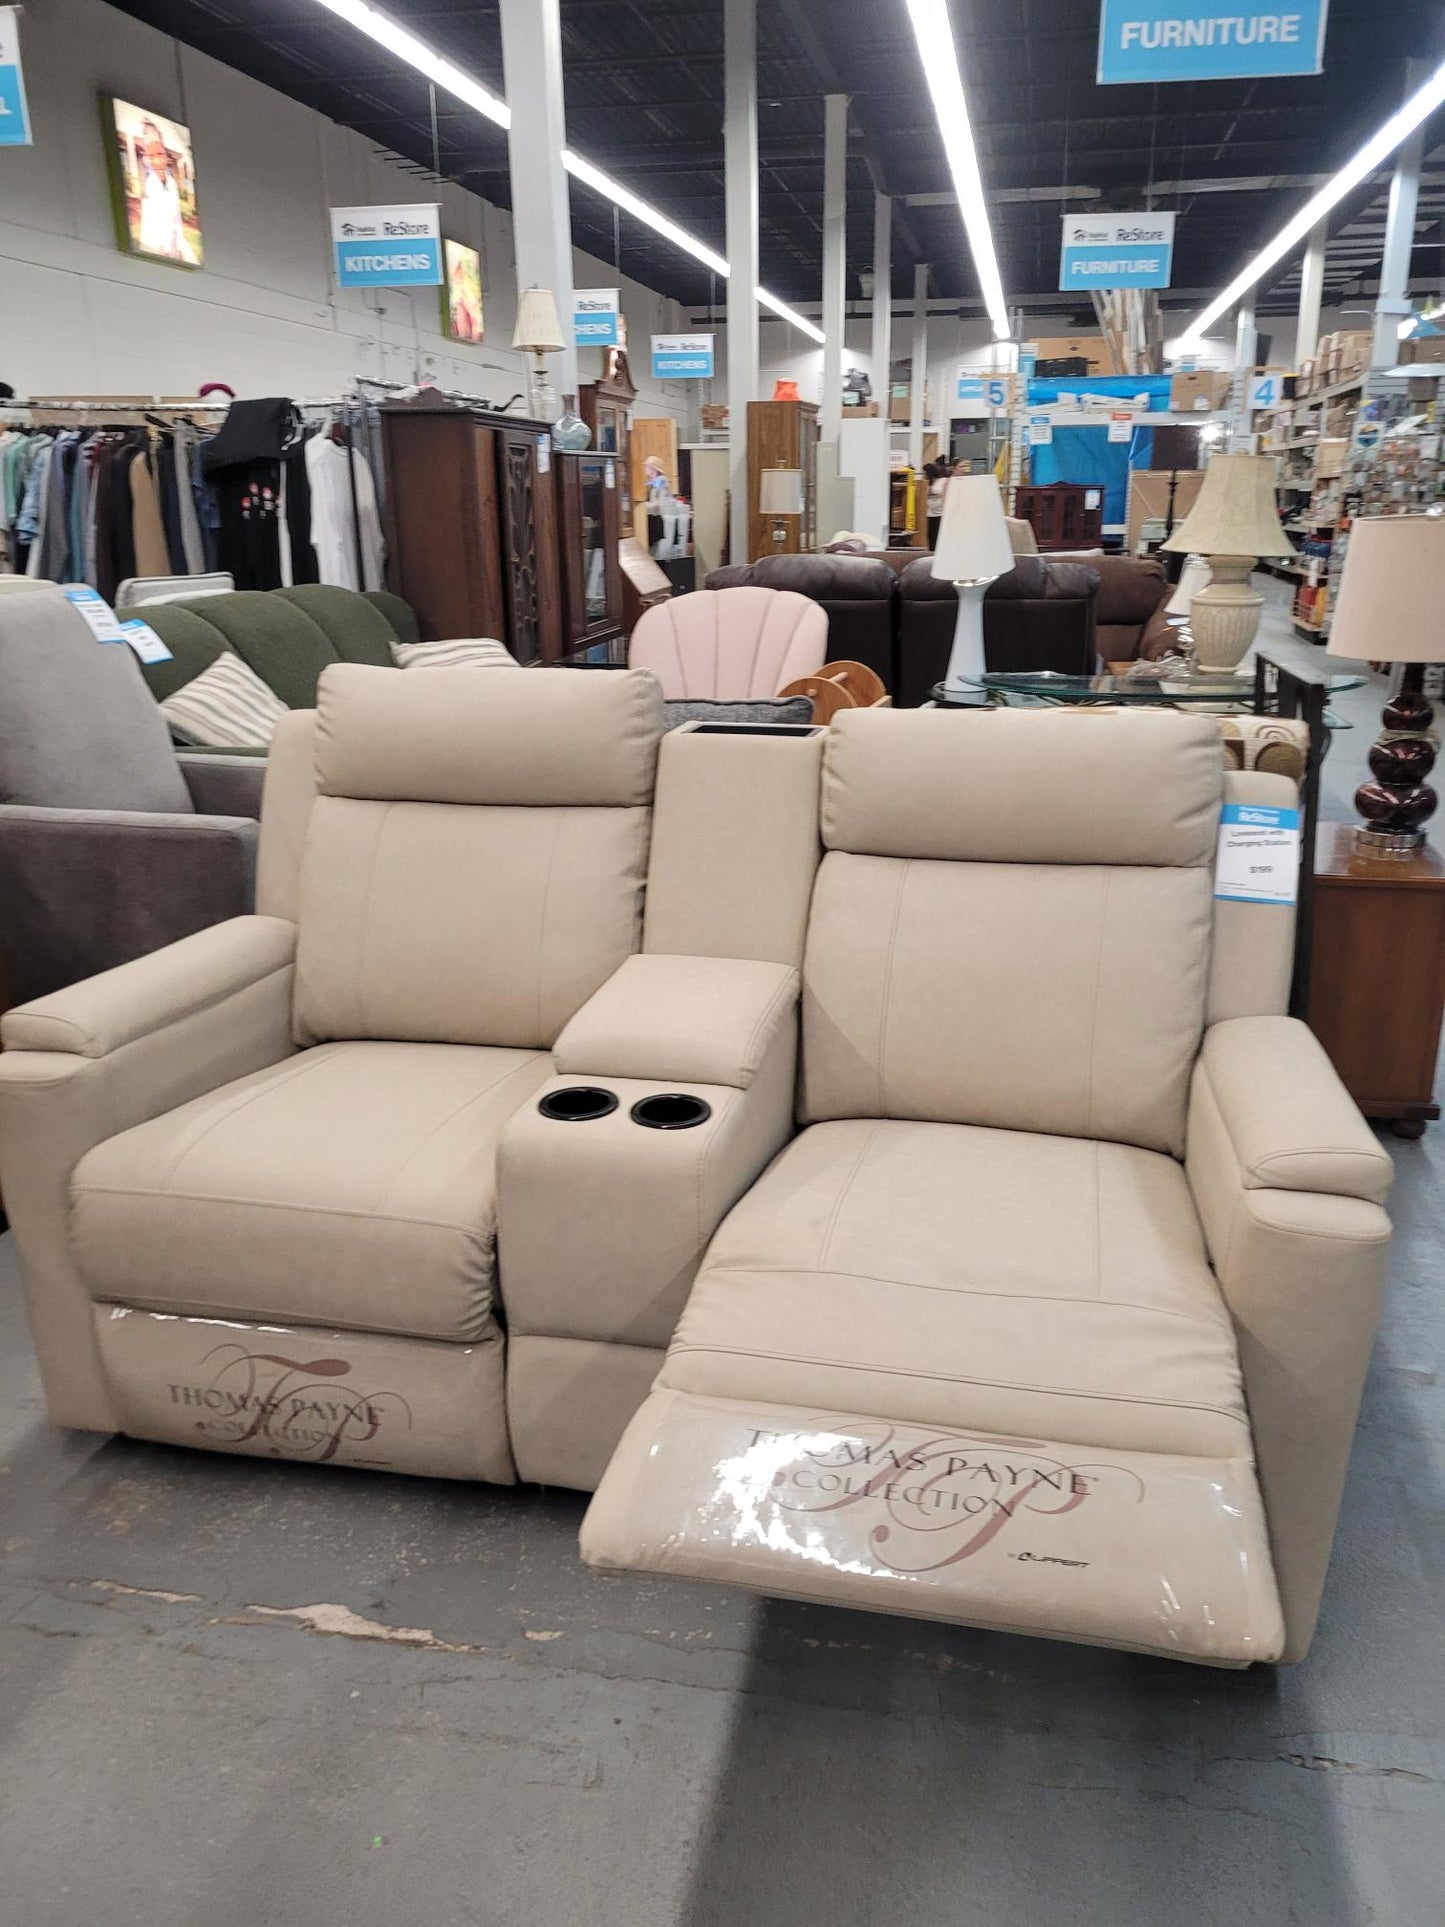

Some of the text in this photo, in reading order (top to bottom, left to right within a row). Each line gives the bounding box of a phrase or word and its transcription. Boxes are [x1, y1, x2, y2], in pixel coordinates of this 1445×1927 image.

[1120, 14, 1301, 50] FURNITURE
[383, 221, 431, 236] ReStore
[1116, 228, 1165, 242] ReStore
[344, 253, 432, 272] KITCHENS
[1070, 259, 1160, 275] FURNITURE
[577, 300, 612, 311] ReStore
[657, 359, 709, 370] KITCHENS
[987, 381, 1005, 406] 5
[1253, 378, 1276, 406] 4
[1238, 811, 1280, 825] ReStore
[1226, 841, 1262, 849] Charging
[167, 1383, 385, 1427] THOMAS PAYNE
[946, 1456, 1094, 1496] PAYNE
[792, 1469, 1017, 1519] COLLECTION
